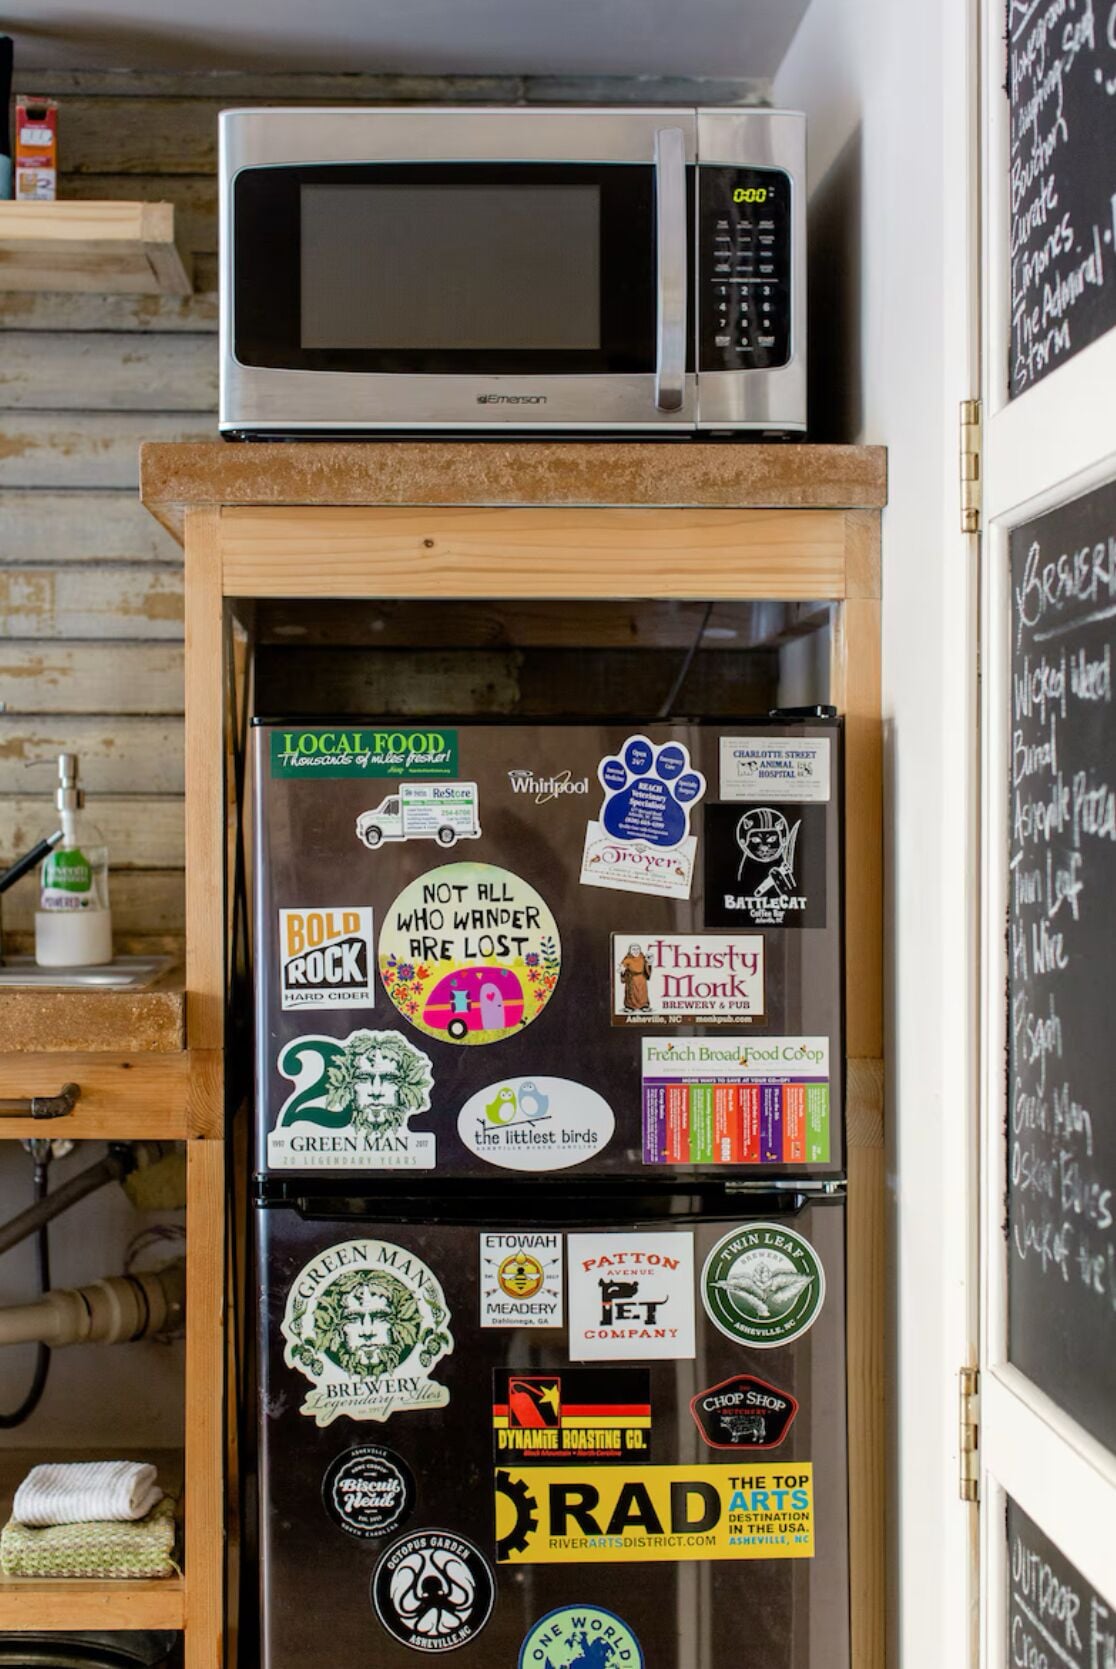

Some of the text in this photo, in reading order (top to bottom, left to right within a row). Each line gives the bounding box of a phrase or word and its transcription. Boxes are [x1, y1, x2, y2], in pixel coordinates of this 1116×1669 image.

[733, 189, 767, 203] 0:00
[720, 286, 725, 295] 1
[741, 286, 748, 295] 2
[763, 286, 770, 295] 3
[719, 302, 726, 311] 4
[741, 302, 748, 311] 5
[763, 302, 770, 312] 6
[720, 319, 726, 327] 7
[487, 395, 547, 404] Emerson
[283, 733, 446, 754] LOCAL FOOD
[278, 749, 452, 768] Thousands of miles fresher!
[733, 751, 818, 761] CHARLOTTE STREET
[758, 761, 794, 770] ANIMAL
[758, 770, 797, 779] HOSPITAL
[433, 788, 472, 799] ReStore
[512, 776, 588, 795] Whirlpool
[423, 883, 515, 904] NOT ALL
[397, 907, 541, 932] WHO WANDER
[287, 912, 361, 957] BOLD
[410, 935, 530, 961] ARE LOST
[287, 941, 367, 986] ROCK
[648, 940, 761, 977] Thirsty
[661, 974, 749, 998] Monk
[285, 991, 370, 1002] HARD CIDER
[662, 1001, 717, 1010] BREWERY
[729, 1001, 751, 1010] PUB
[668, 1015, 683, 1024] NC
[647, 1046, 696, 1061] French
[698, 1046, 741, 1061] Broad
[744, 1046, 779, 1061] Food
[290, 1136, 358, 1152] GREEN
[363, 1136, 409, 1152] MAN
[475, 1128, 599, 1145] the littlest birds
[486, 1235, 558, 1248] ETOWAH
[720, 1233, 804, 1261] TWIN LEAF
[581, 1253, 680, 1272] PATTON
[296, 1246, 431, 1300] GREEN MAN
[486, 1303, 558, 1315] MEADERY
[598, 1278, 668, 1326] PET
[584, 1328, 678, 1341] COMPANY
[326, 1377, 421, 1400] BREWERY
[703, 1391, 787, 1412] CHOP SHOP
[625, 1430, 648, 1449] CO.
[339, 1478, 401, 1497] Biscuit
[728, 1474, 810, 1490] THE TOP
[344, 1491, 395, 1513] Head
[548, 1481, 721, 1536] RAD
[728, 1490, 810, 1511] ARTS
[728, 1512, 810, 1524] DESTINATION
[728, 1522, 810, 1534] IN THE USA.
[549, 1535, 717, 1550] RIVERARTSDISTRICT.COM
[728, 1534, 810, 1546] ASHEVILLE, NC
[387, 1537, 470, 1570] OCTOPUS GARDEN
[532, 1616, 631, 1661] ONE WORLD
